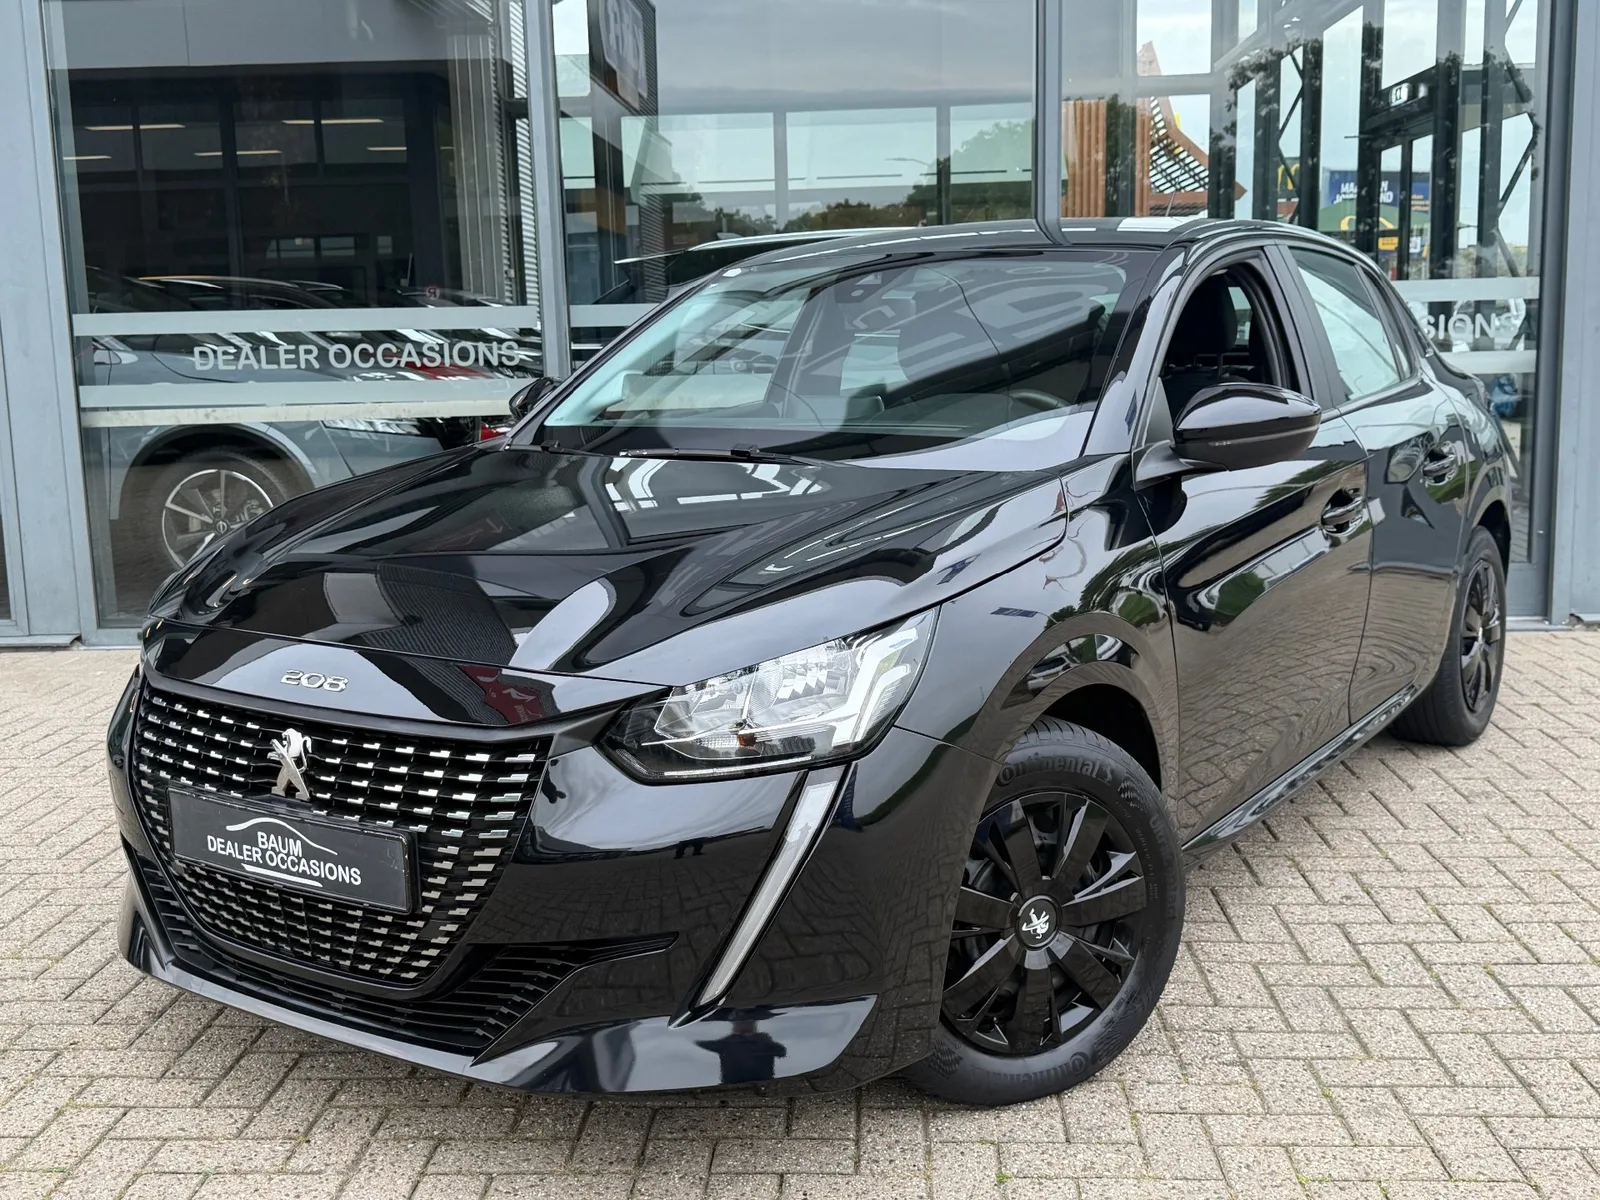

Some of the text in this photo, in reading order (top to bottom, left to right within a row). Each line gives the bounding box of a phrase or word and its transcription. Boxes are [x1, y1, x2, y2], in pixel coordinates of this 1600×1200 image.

[193, 340, 520, 371] DEALER OCCASIONS
[280, 669, 349, 692] 208
[257, 831, 302, 857] BAUM
[206, 835, 362, 886] DEALER OCCASIONS
